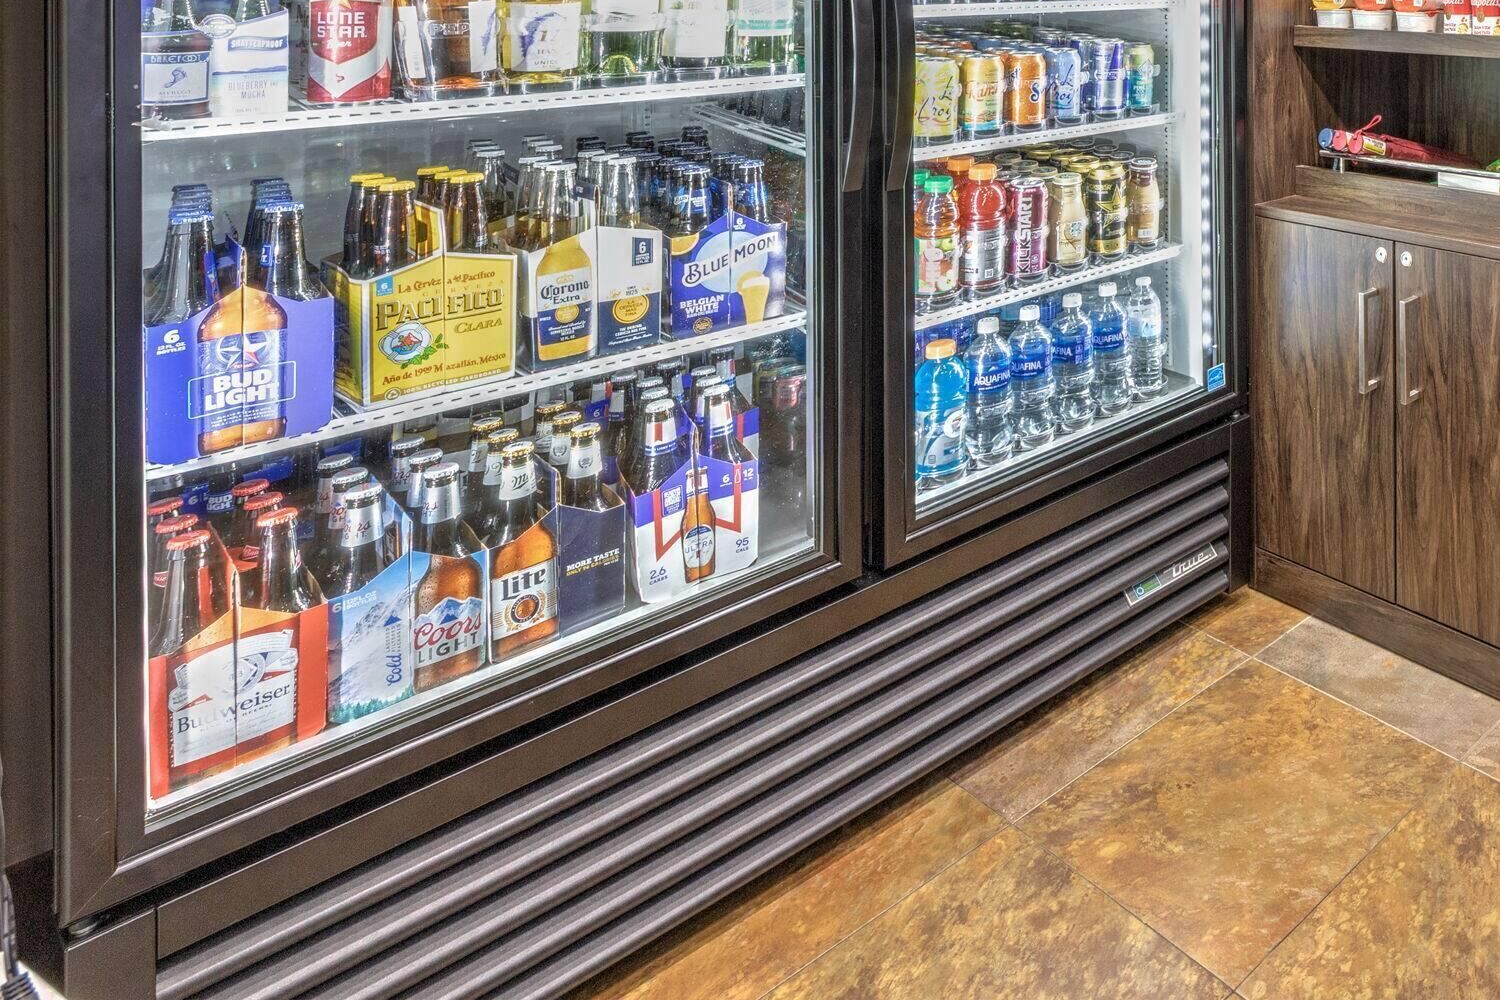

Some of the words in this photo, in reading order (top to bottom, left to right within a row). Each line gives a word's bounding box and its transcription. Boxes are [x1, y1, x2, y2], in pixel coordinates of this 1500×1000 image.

[317, 11, 365, 24] LONE
[639, 241, 646, 253] 6
[685, 253, 728, 284] BLUE
[734, 235, 776, 263] MOON
[541, 281, 590, 300] Corona
[553, 295, 580, 304] Extra
[680, 294, 724, 309] BELGIAN
[454, 318, 502, 334] CLARA
[163, 329, 180, 343] 6
[213, 369, 272, 393] BUD
[460, 368, 502, 381] CARDBOARD
[974, 370, 1011, 385] AQUAFINA
[204, 382, 279, 411] LIGHT
[722, 474, 730, 483] 6
[743, 468, 754, 477] 12
[215, 495, 232, 503] BUD
[685, 539, 713, 553] ULTRA
[736, 537, 749, 547] 95
[566, 557, 592, 571] MORE
[593, 548, 619, 562] TASTE
[650, 566, 666, 580] 2.6
[501, 568, 546, 600] Lite
[332, 602, 342, 613] 6
[414, 613, 482, 650] Coors
[418, 632, 478, 663] LIGHT
[386, 655, 402, 687] Cold
